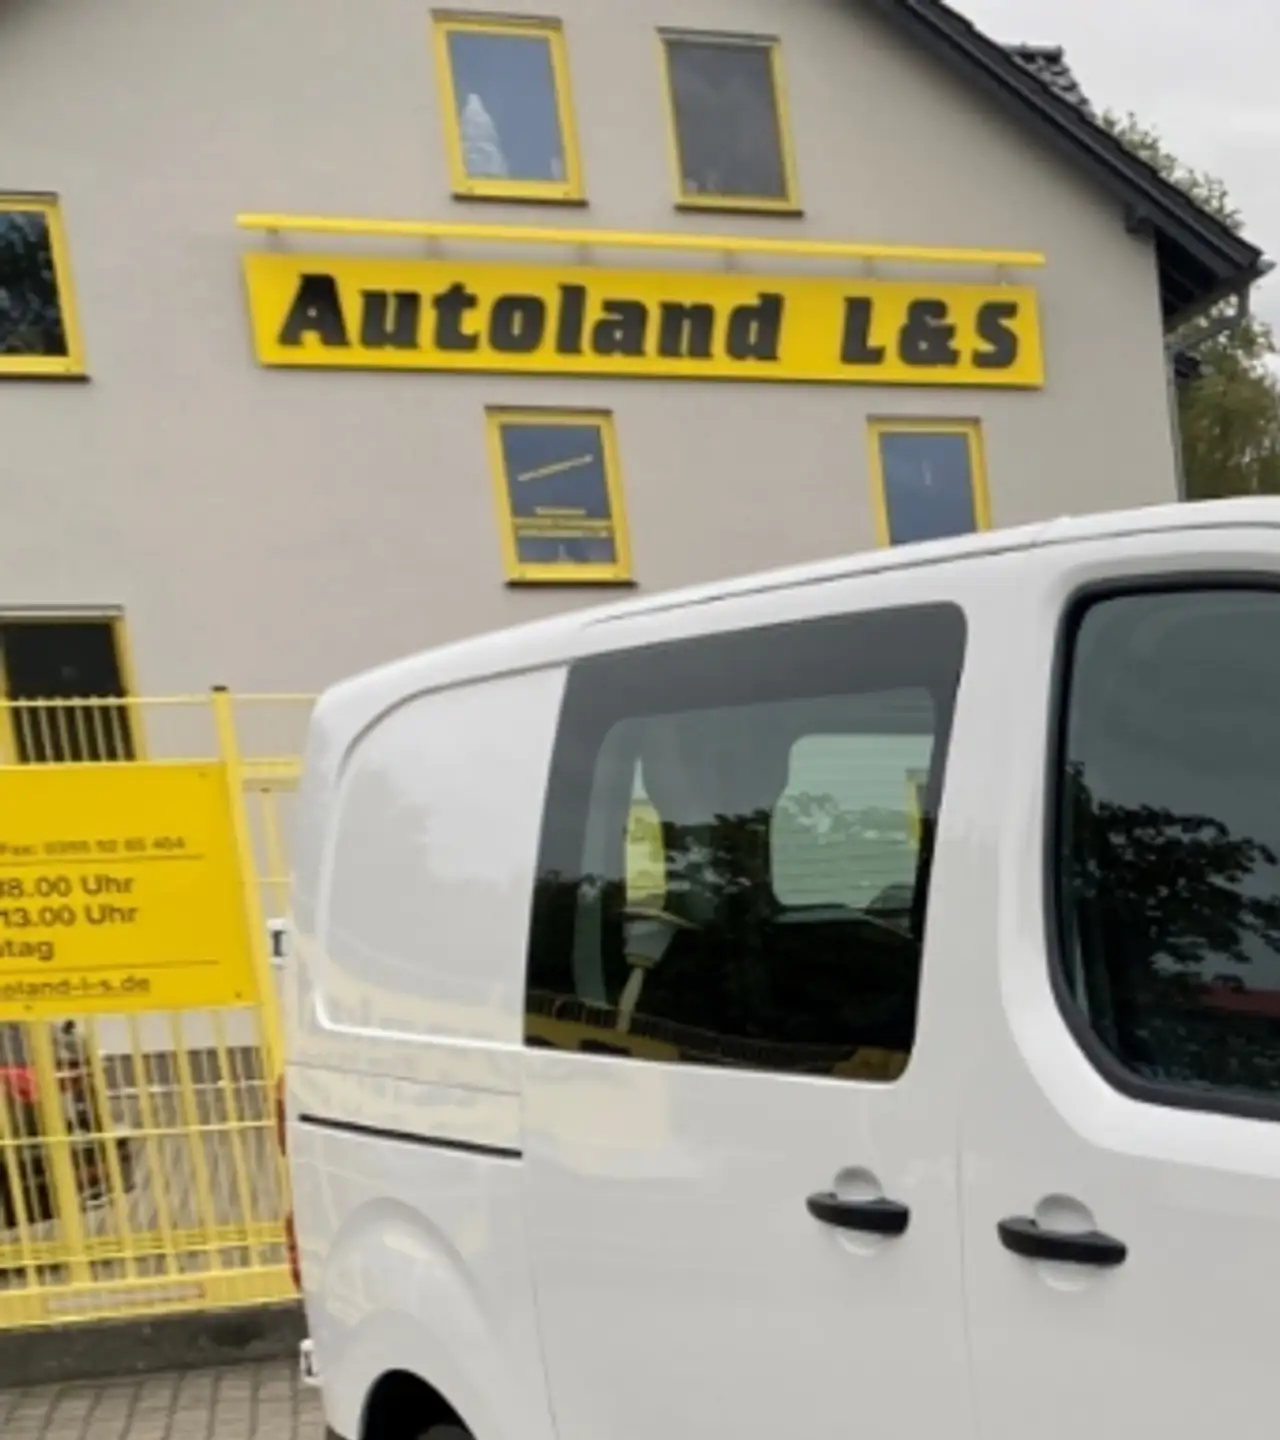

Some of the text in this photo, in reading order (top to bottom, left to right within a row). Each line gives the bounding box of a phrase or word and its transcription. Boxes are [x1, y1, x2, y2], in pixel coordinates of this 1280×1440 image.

[276, 273, 1021, 370] Autoland L&S
[80, 873, 135, 896] Uhr
[0, 903, 139, 928] 13.00 Uhr
